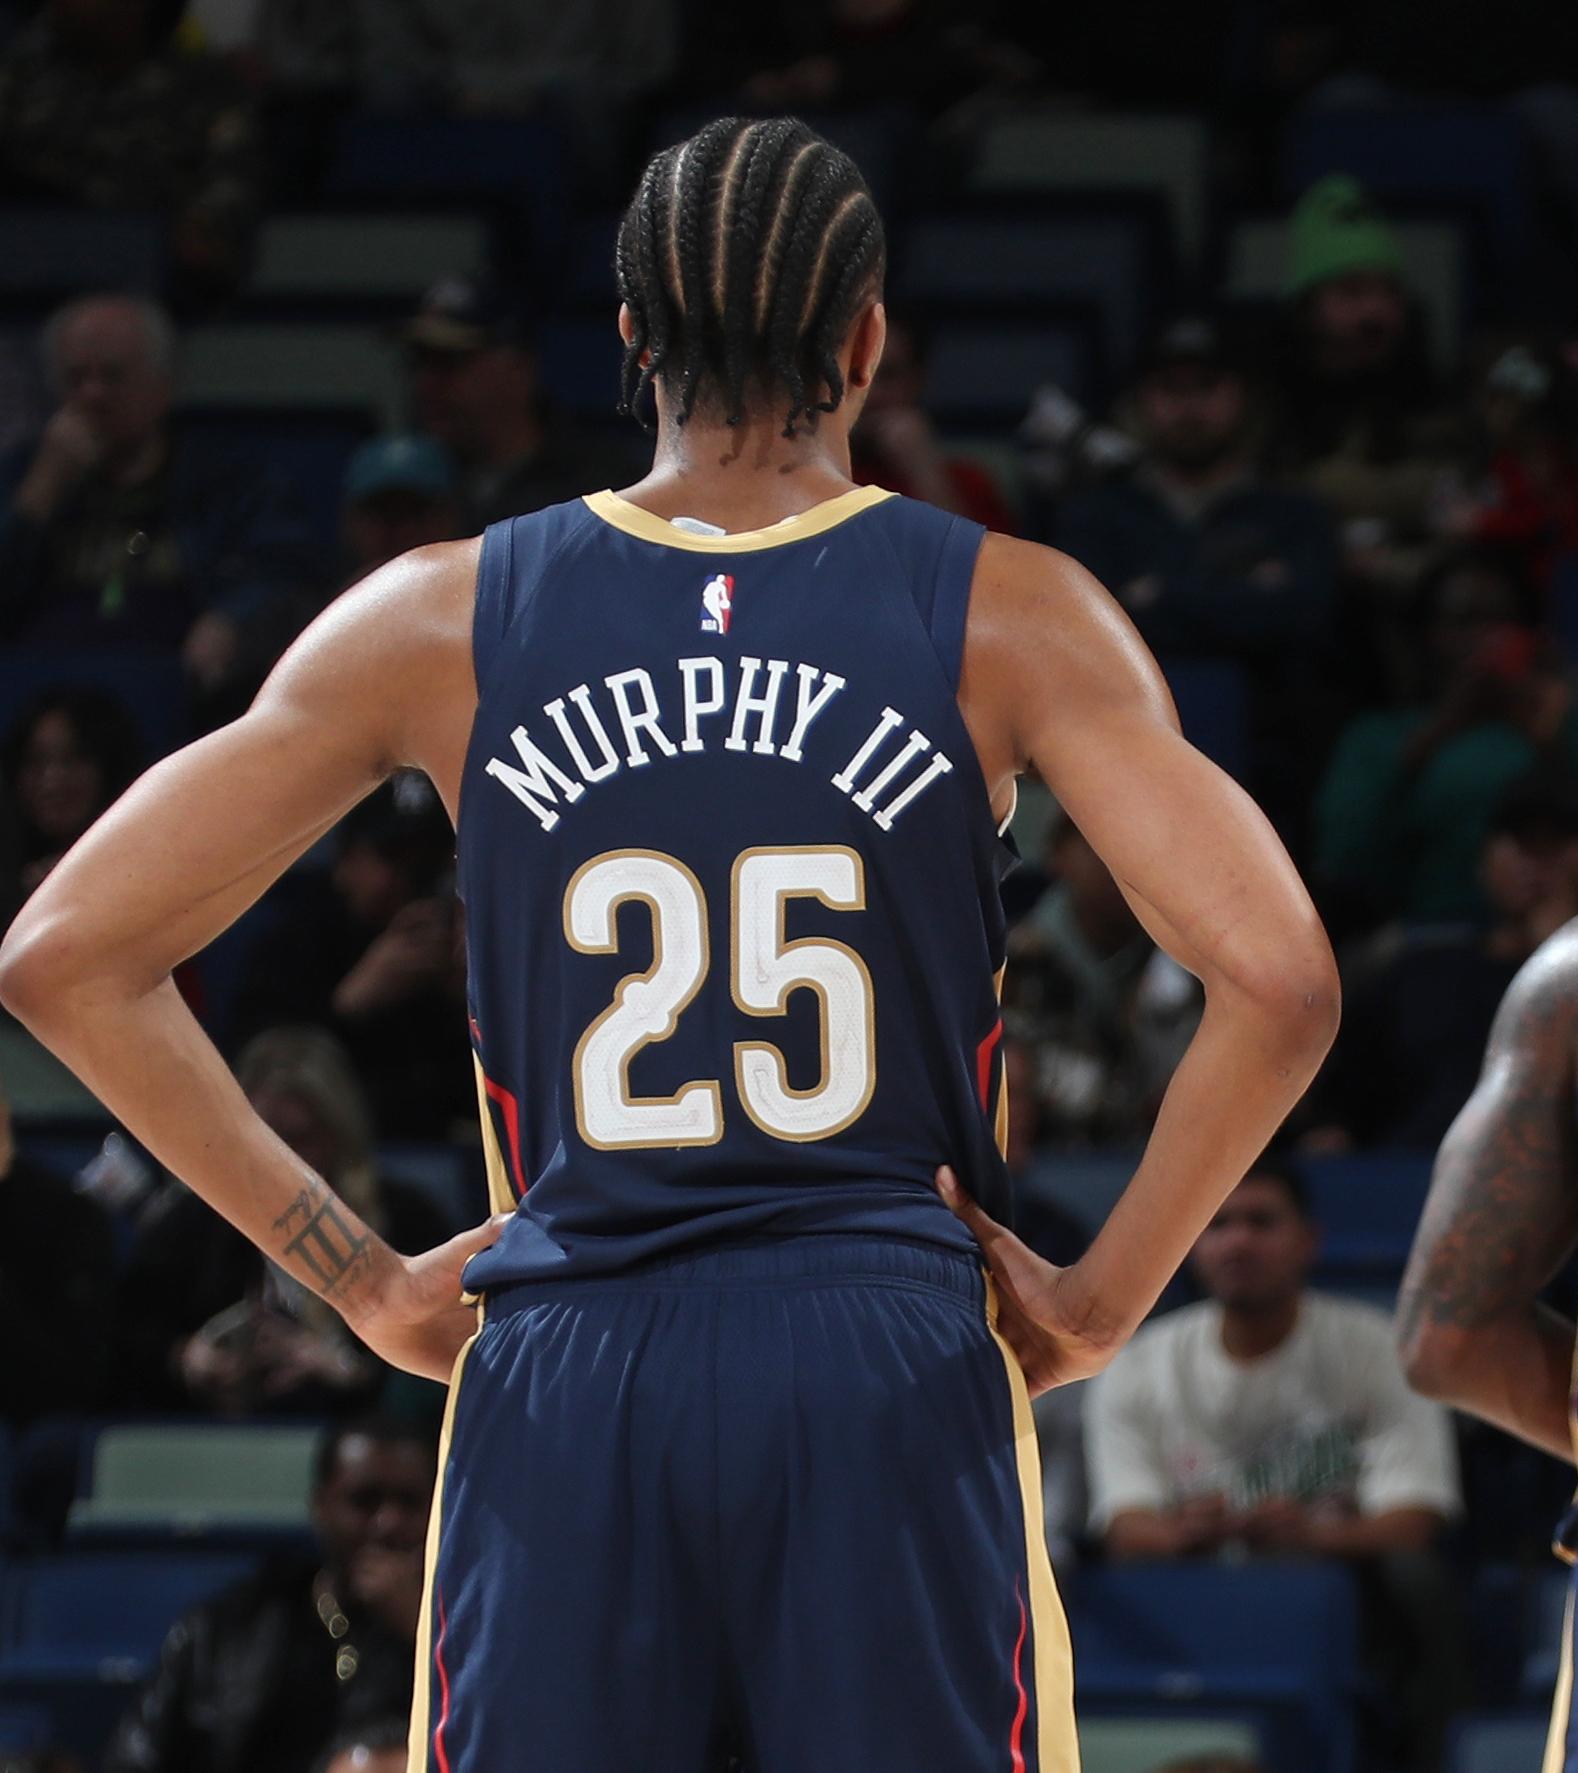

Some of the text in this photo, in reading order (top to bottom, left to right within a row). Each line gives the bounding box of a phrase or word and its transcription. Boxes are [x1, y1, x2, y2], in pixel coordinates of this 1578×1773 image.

[483, 655, 955, 833] MURPHY III
[561, 843, 877, 1152] 25
